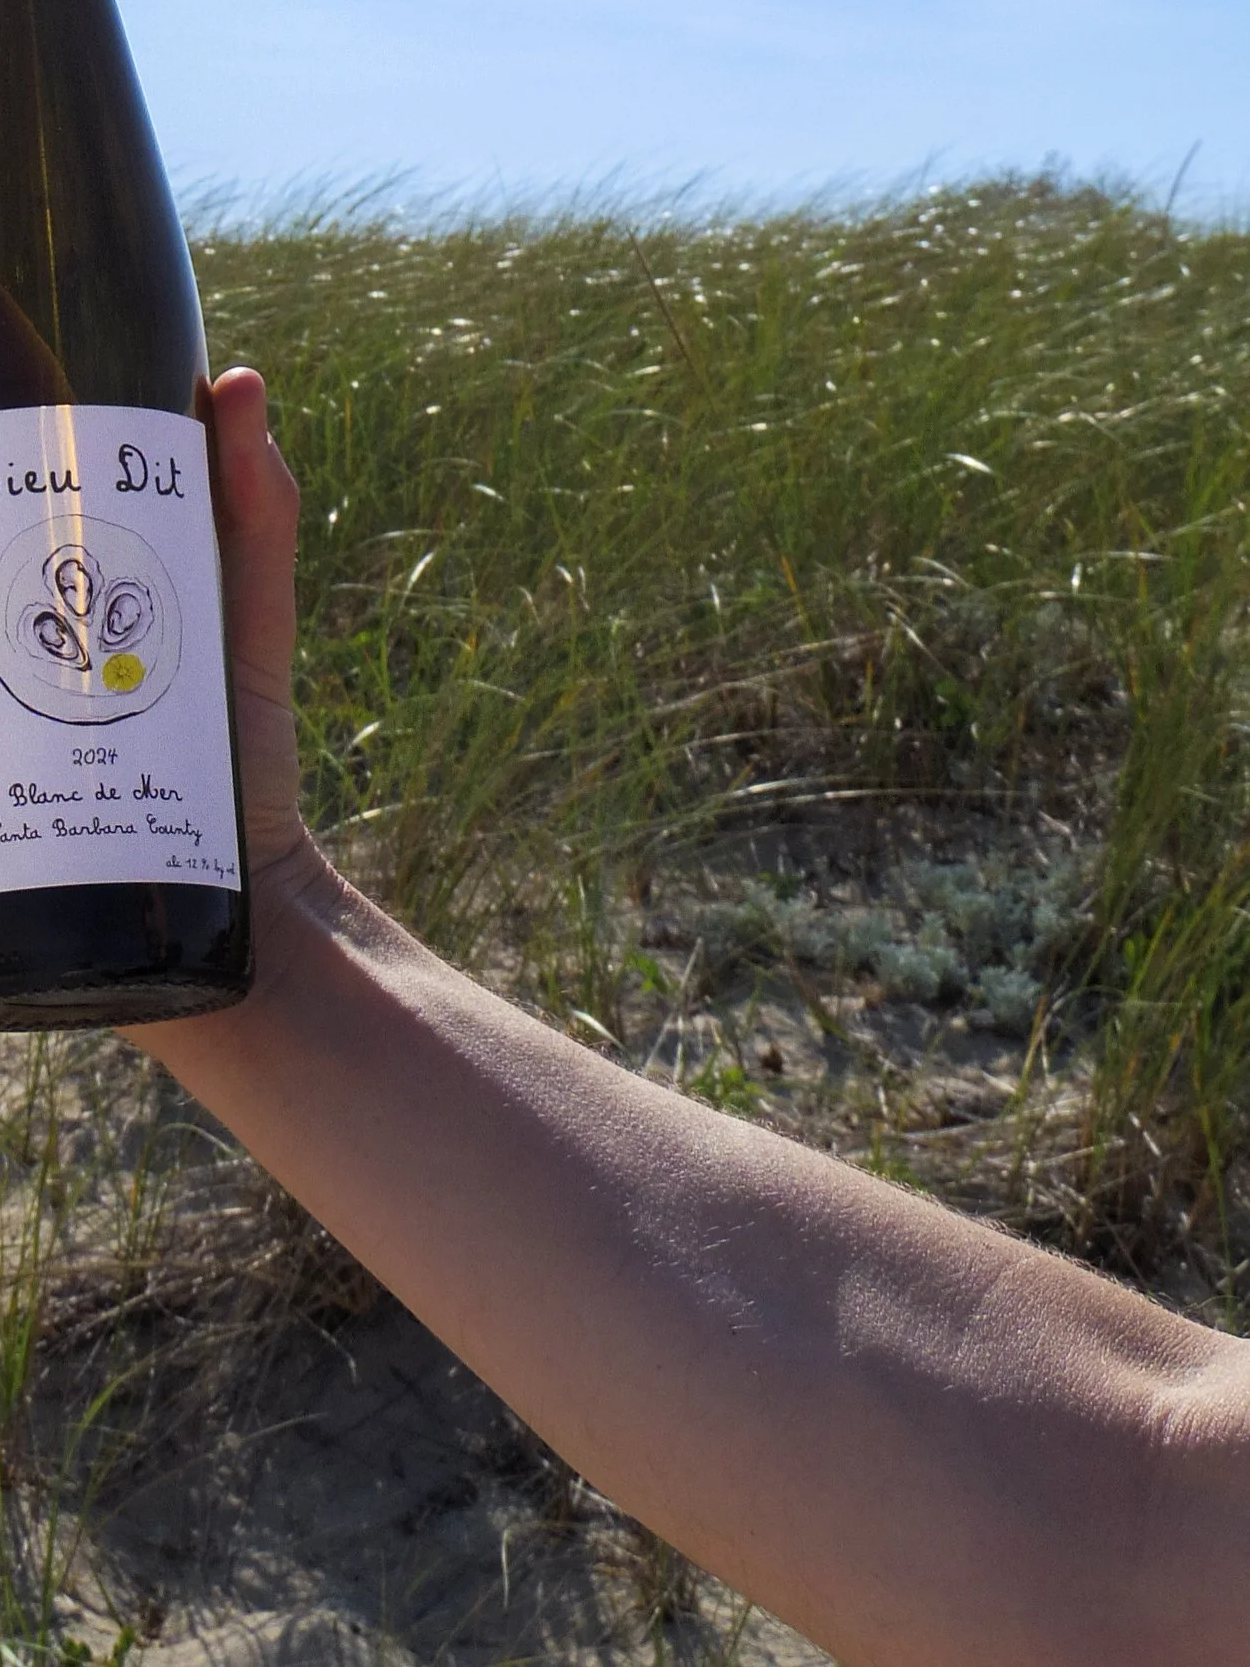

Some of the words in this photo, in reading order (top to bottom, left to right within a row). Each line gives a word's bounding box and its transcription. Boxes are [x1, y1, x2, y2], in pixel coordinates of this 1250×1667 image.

[116, 444, 185, 498] Dit
[72, 747, 118, 766] 2024
[9, 783, 83, 806] Blanc
[95, 783, 121, 800] de
[133, 774, 183, 801] Mer
[52, 817, 137, 838] Barbara
[146, 814, 203, 846] County
